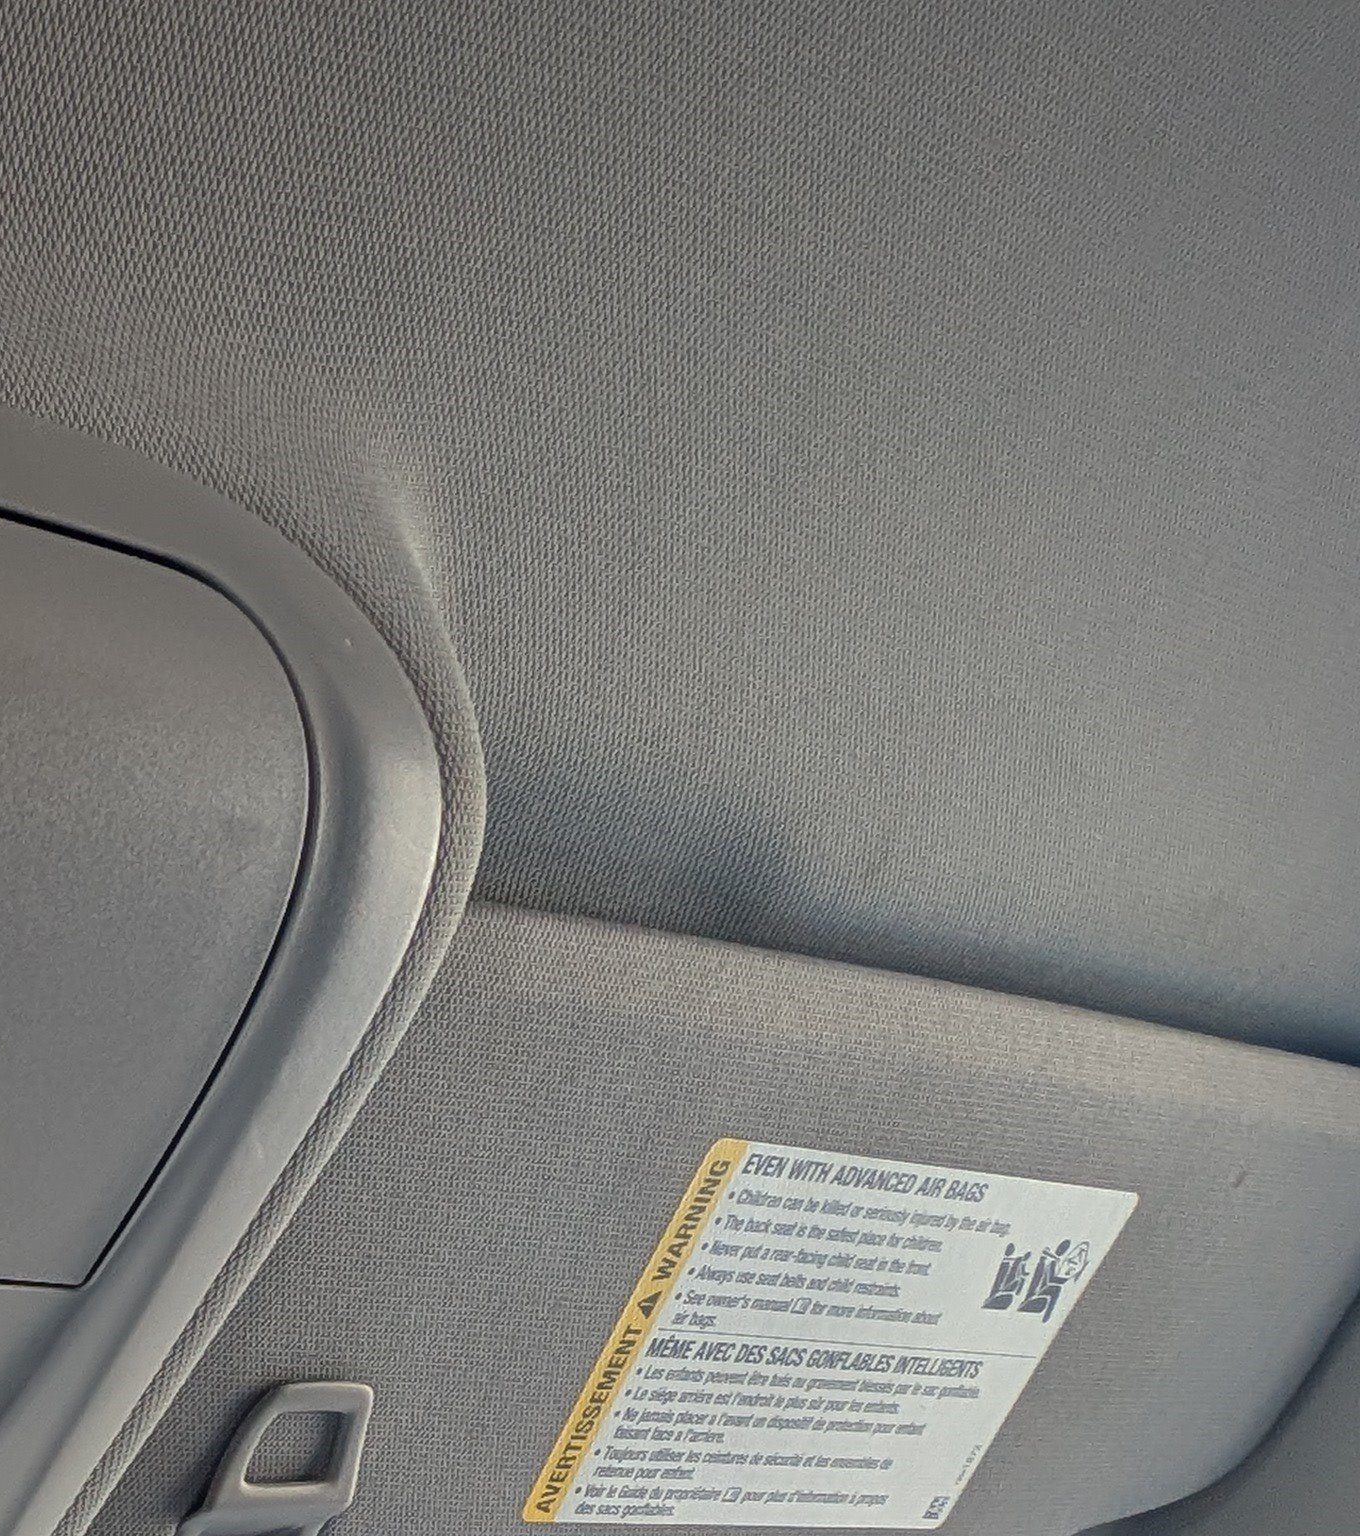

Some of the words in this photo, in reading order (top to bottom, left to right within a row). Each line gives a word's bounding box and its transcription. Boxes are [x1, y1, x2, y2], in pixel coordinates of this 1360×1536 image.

[742, 1153, 790, 1178] EVEN
[788, 1158, 834, 1183] WITH
[830, 1165, 918, 1193] ADVANCED
[914, 1177, 946, 1198] AIR
[944, 1180, 989, 1202] BAGS
[736, 1188, 782, 1208] Children
[782, 1197, 803, 1210] can
[803, 1197, 820, 1213] be
[652, 1160, 730, 1282] WARNING
[724, 1215, 744, 1230] The
[744, 1219, 771, 1232] back
[772, 1221, 797, 1236] seat
[709, 1240, 744, 1256] Never
[740, 1243, 764, 1260] put
[760, 1248, 770, 1260] a
[694, 1265, 736, 1285] Always
[735, 1271, 756, 1284] use
[755, 1273, 782, 1286] seat
[779, 1273, 807, 1288] belts
[806, 1278, 830, 1290] and
[683, 1290, 706, 1306] See
[671, 1310, 689, 1325] air
[645, 1333, 696, 1359] MÊME
[692, 1341, 736, 1362] AVEC
[734, 1344, 768, 1364] DES
[765, 1347, 807, 1367] SACS
[806, 1350, 895, 1373] GONFLABLES
[892, 1356, 983, 1379] INTELLIGENTS
[643, 1365, 665, 1380] Les
[633, 1386, 649, 1400] Le
[537, 1324, 644, 1514] AVERTISSEMENT
[575, 1501, 596, 1515] des
